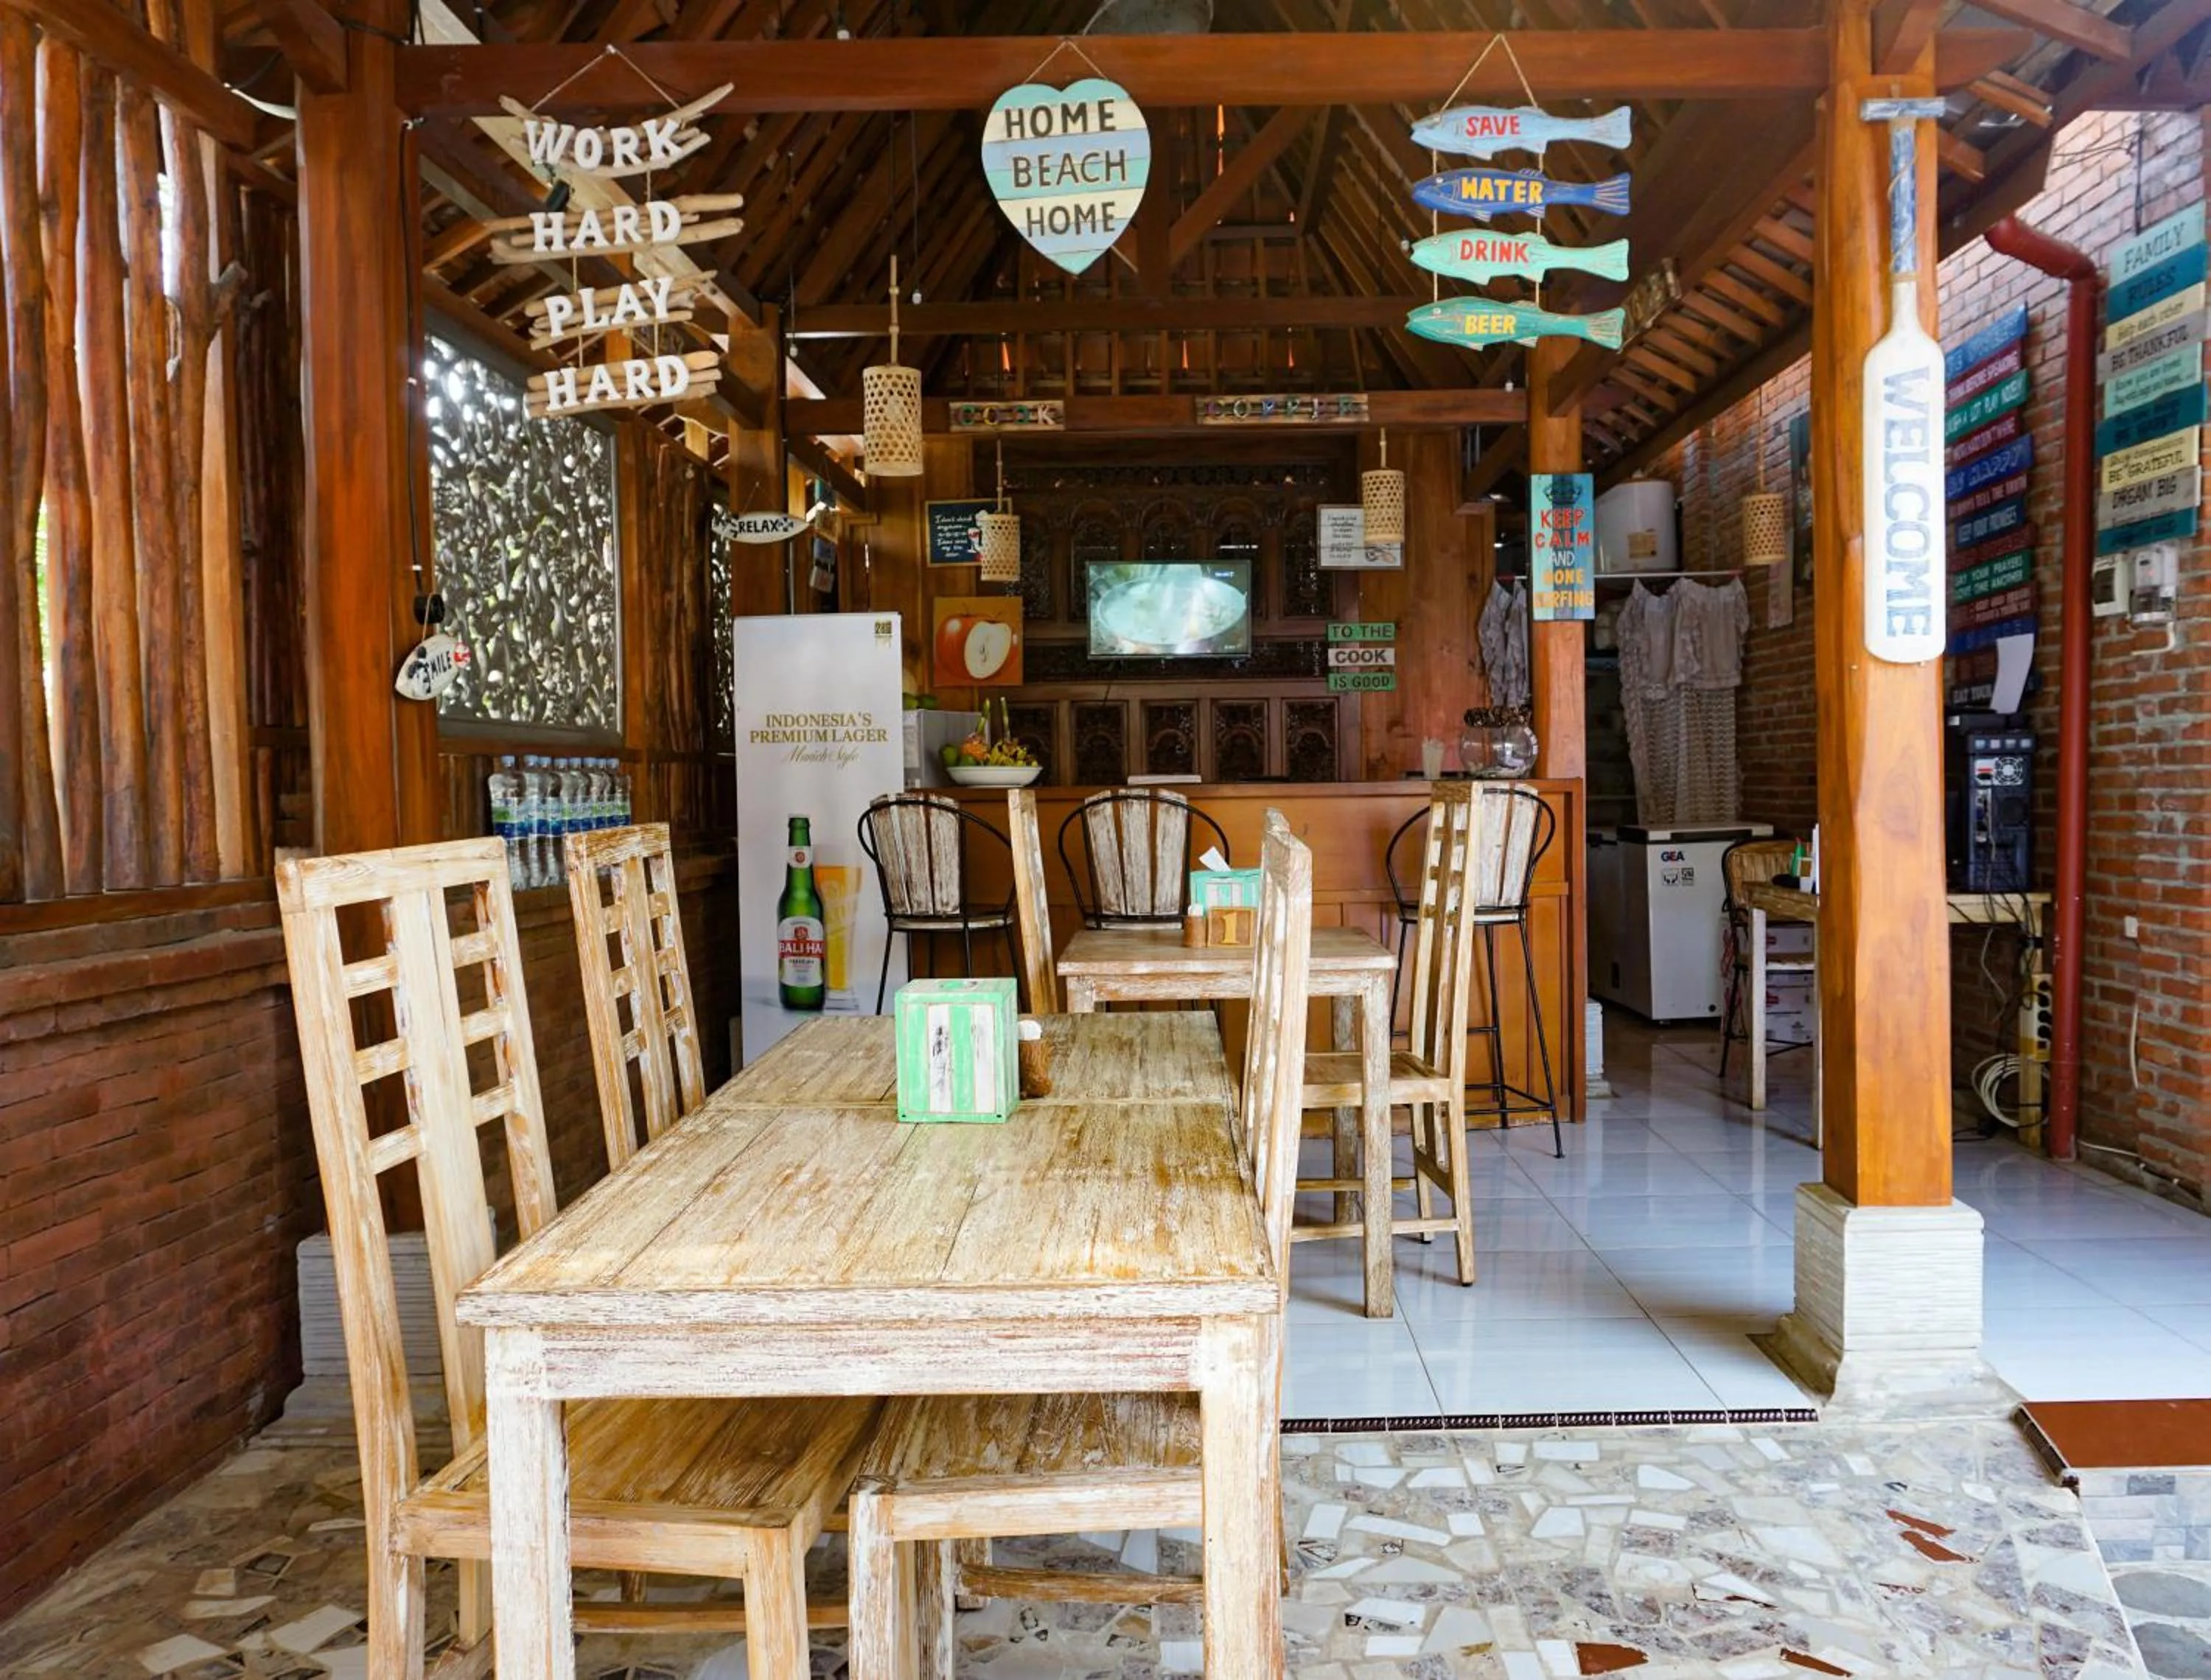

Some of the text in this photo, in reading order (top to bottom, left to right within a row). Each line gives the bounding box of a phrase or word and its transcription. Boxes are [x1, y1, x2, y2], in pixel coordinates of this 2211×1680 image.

[1005, 99, 1117, 138] HOME
[1465, 115, 1520, 137] SAVE
[524, 118, 683, 169] WORK
[1013, 150, 1127, 189] BEACH
[1461, 177, 1544, 204] WATER
[529, 201, 682, 252] HARD
[1027, 202, 1116, 238] HOME
[1460, 239, 1530, 263] DRINK
[2124, 222, 2185, 273] FAMILY
[545, 277, 673, 337] PLAY
[1464, 314, 1518, 335] BEER
[544, 354, 691, 411] HARD
[1884, 366, 1932, 637] WELCOME
[738, 519, 779, 533] RELAX
[1540, 509, 1585, 529] KEEP
[1534, 531, 1592, 549] CALM
[1550, 550, 1575, 567] AND
[1332, 625, 1392, 638] TO THE
[1335, 650, 1387, 664] COOK
[1333, 675, 1390, 688] IS GOOD
[765, 712, 873, 728] INDONESIA'S
[750, 729, 889, 744] PREMIUM LAGER
[1660, 850, 1686, 862] GEA
[1220, 911, 1240, 945] 1
[779, 942, 804, 953] BALI
